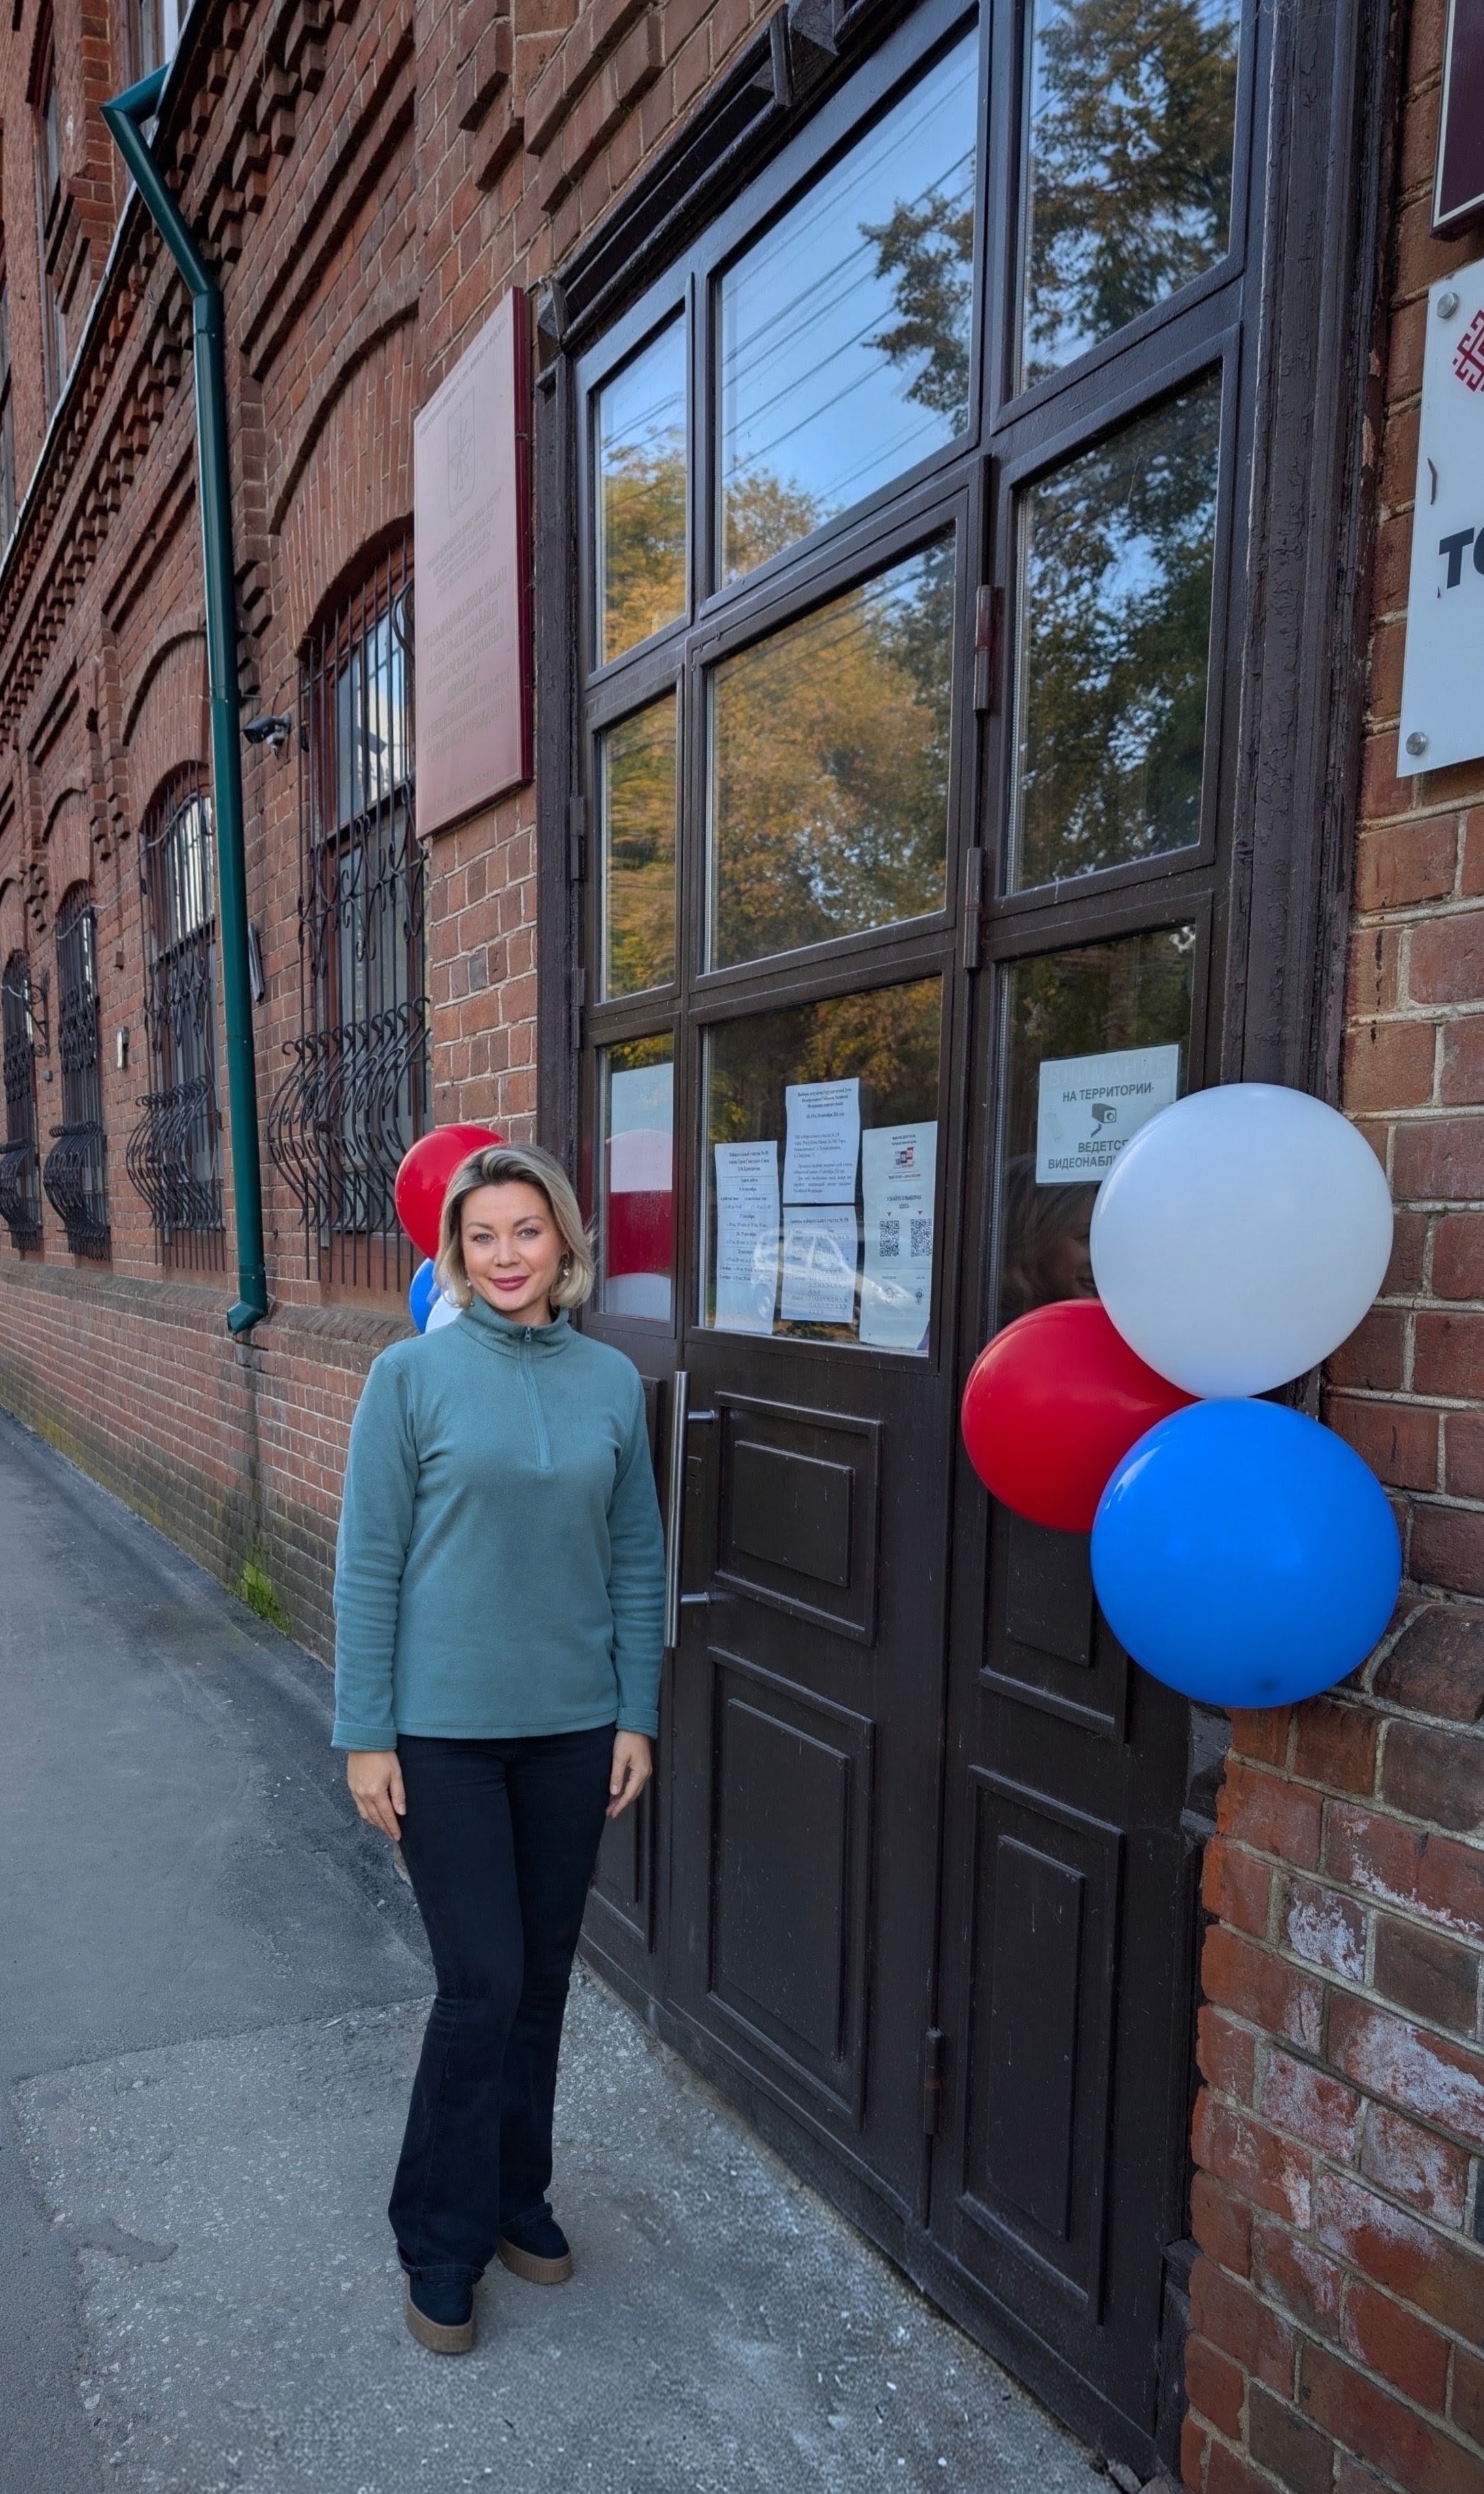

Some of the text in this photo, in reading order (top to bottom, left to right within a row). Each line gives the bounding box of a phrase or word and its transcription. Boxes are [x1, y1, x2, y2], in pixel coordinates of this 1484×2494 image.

[1063, 1083, 1152, 1102] НА ТЕРРИТОРИИ
[1048, 1155, 1116, 1170] ВИДЕОНАБЛ
